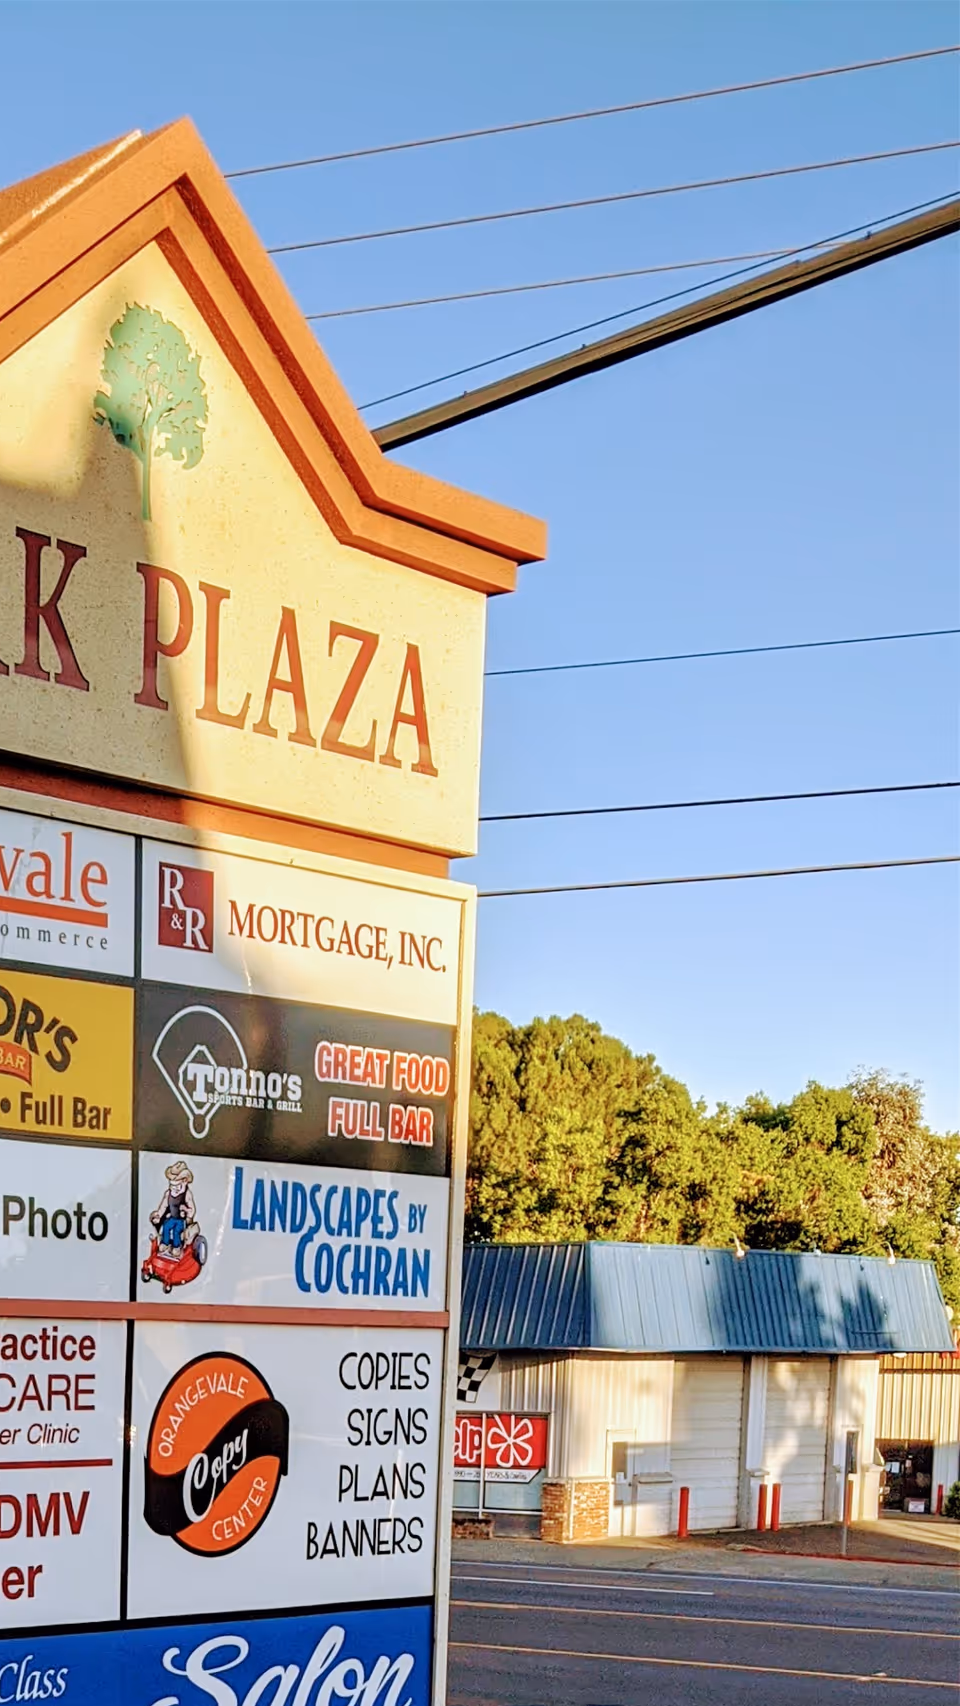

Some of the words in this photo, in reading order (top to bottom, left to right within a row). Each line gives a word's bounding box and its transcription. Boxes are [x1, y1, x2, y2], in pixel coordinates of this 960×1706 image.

[135, 561, 439, 778] PLAZA
[227, 899, 394, 970] MORTGAGE,
[397, 930, 446, 973] INC.
[314, 1040, 390, 1090] GREAT
[392, 1051, 450, 1098] FOOD
[20, 1091, 64, 1128] Full
[72, 1097, 112, 1132] Bar
[207, 1091, 243, 1107] SPORTS
[245, 1095, 265, 1109] BAR
[275, 1099, 303, 1113] GRILL
[327, 1096, 384, 1142] FULL
[388, 1102, 434, 1147] BAR
[1, 1193, 110, 1242] Photo
[231, 1165, 400, 1241] LANDSCAPES
[407, 1202, 428, 1234] BY
[294, 1224, 432, 1299] COCHRAN
[338, 1351, 432, 1391] COPIES
[25, 1422, 81, 1446] Clinic
[157, 1371, 250, 1459] ORANGEVALE
[346, 1407, 429, 1447] SIGNS
[182, 1427, 250, 1524] Copy
[338, 1461, 427, 1504] PLANS
[211, 1475, 269, 1542] CENTER
[305, 1516, 425, 1561] BANNERS
